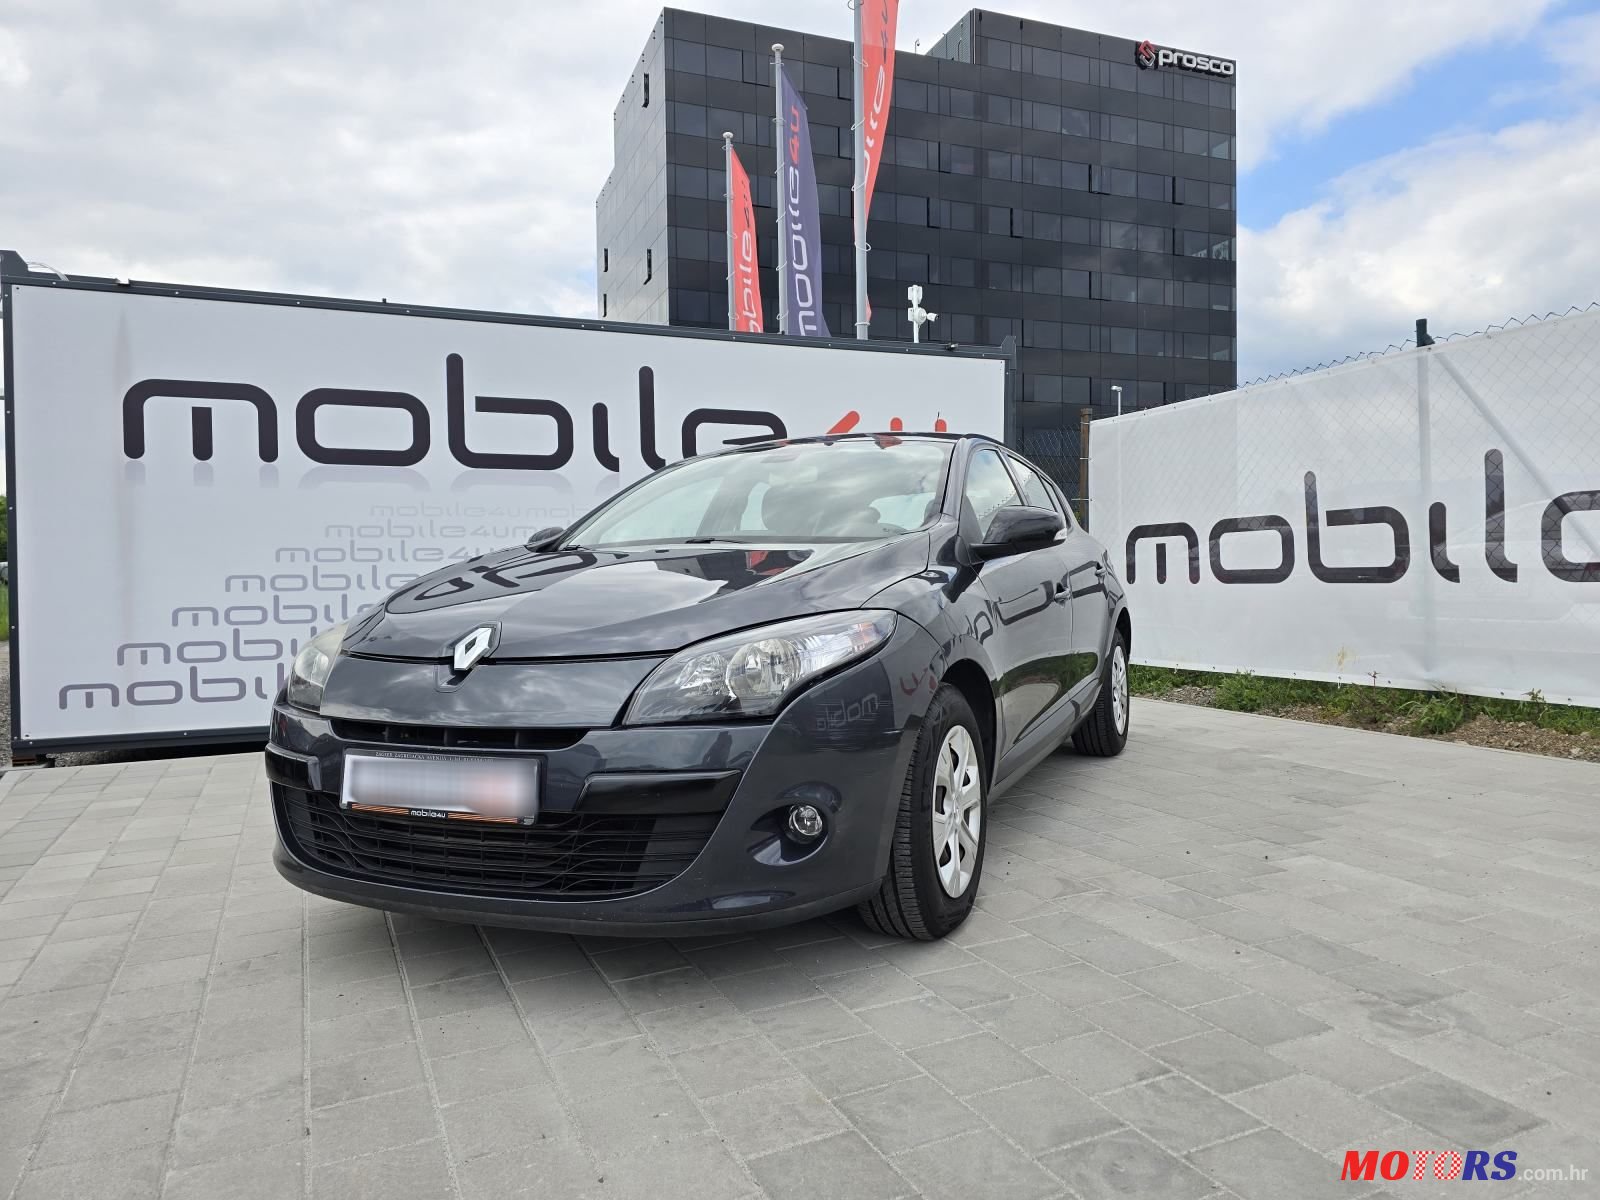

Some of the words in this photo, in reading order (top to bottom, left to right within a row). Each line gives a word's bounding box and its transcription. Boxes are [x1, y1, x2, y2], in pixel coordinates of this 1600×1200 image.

[1158, 49, 1234, 75] prosco
[123, 353, 947, 471] mobile
[117, 626, 317, 666] mobi
